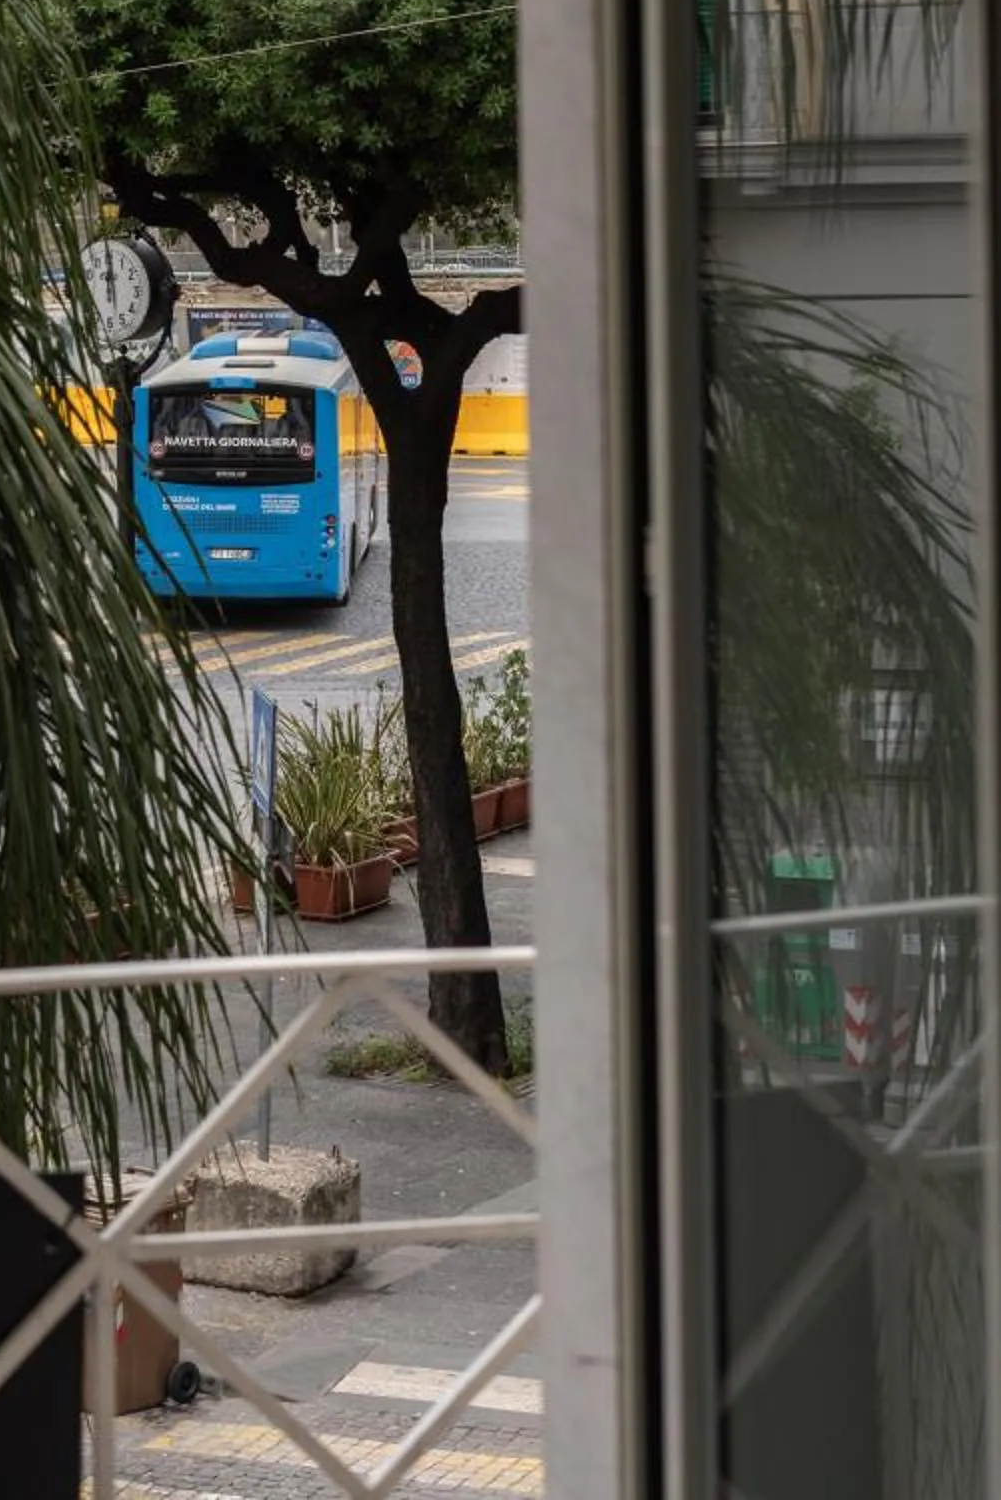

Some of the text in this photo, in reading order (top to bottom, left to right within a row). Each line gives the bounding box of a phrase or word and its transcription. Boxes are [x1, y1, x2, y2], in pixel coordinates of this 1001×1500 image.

[128, 268, 136, 281] 2
[107, 316, 114, 329] 6
[119, 313, 126, 325] 5
[164, 435, 298, 448] NAVETTA GIORNALIERA
